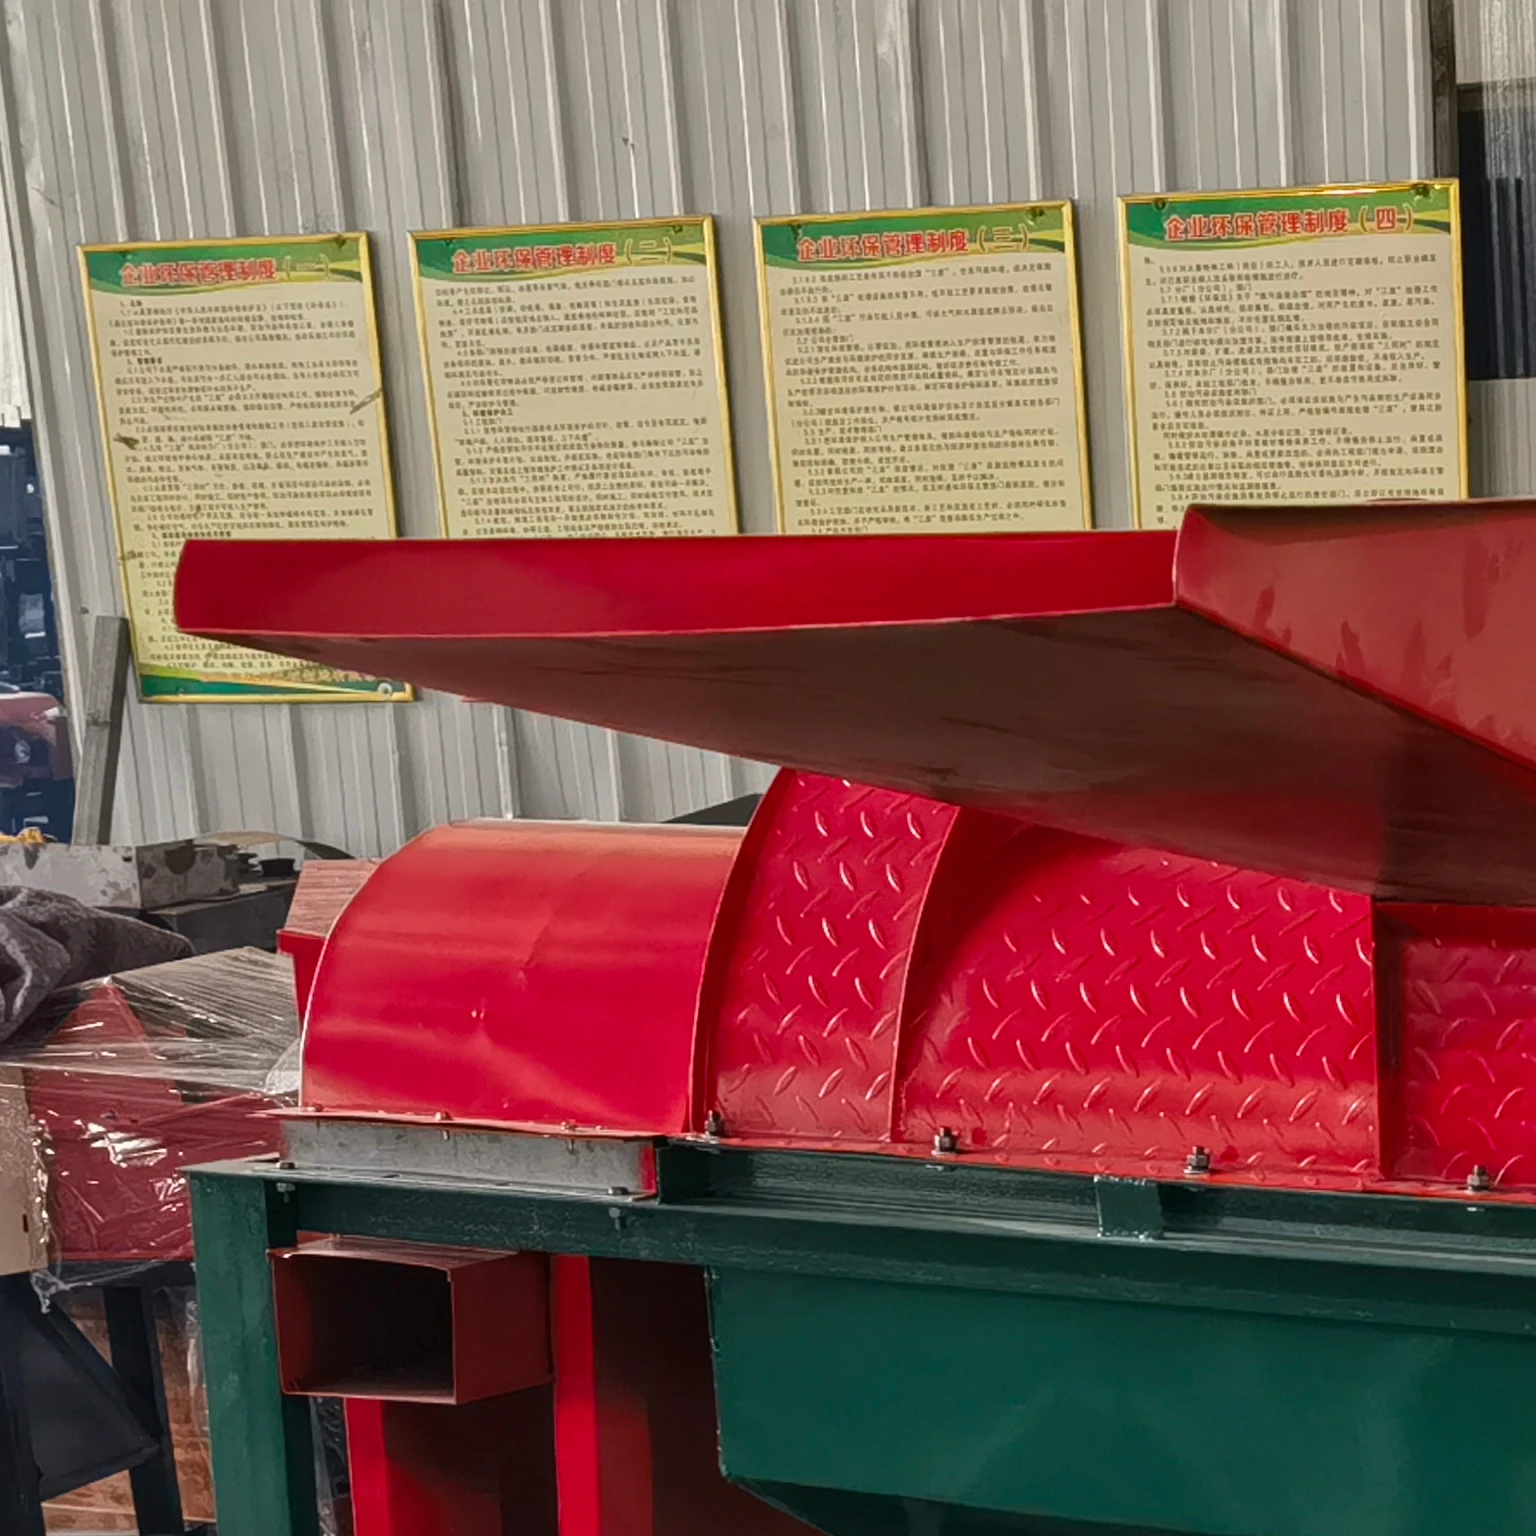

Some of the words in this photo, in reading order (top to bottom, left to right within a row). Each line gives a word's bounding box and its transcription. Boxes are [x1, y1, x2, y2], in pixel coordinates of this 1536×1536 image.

[1165, 205, 1415, 241] 企业环保管理制度（四）
